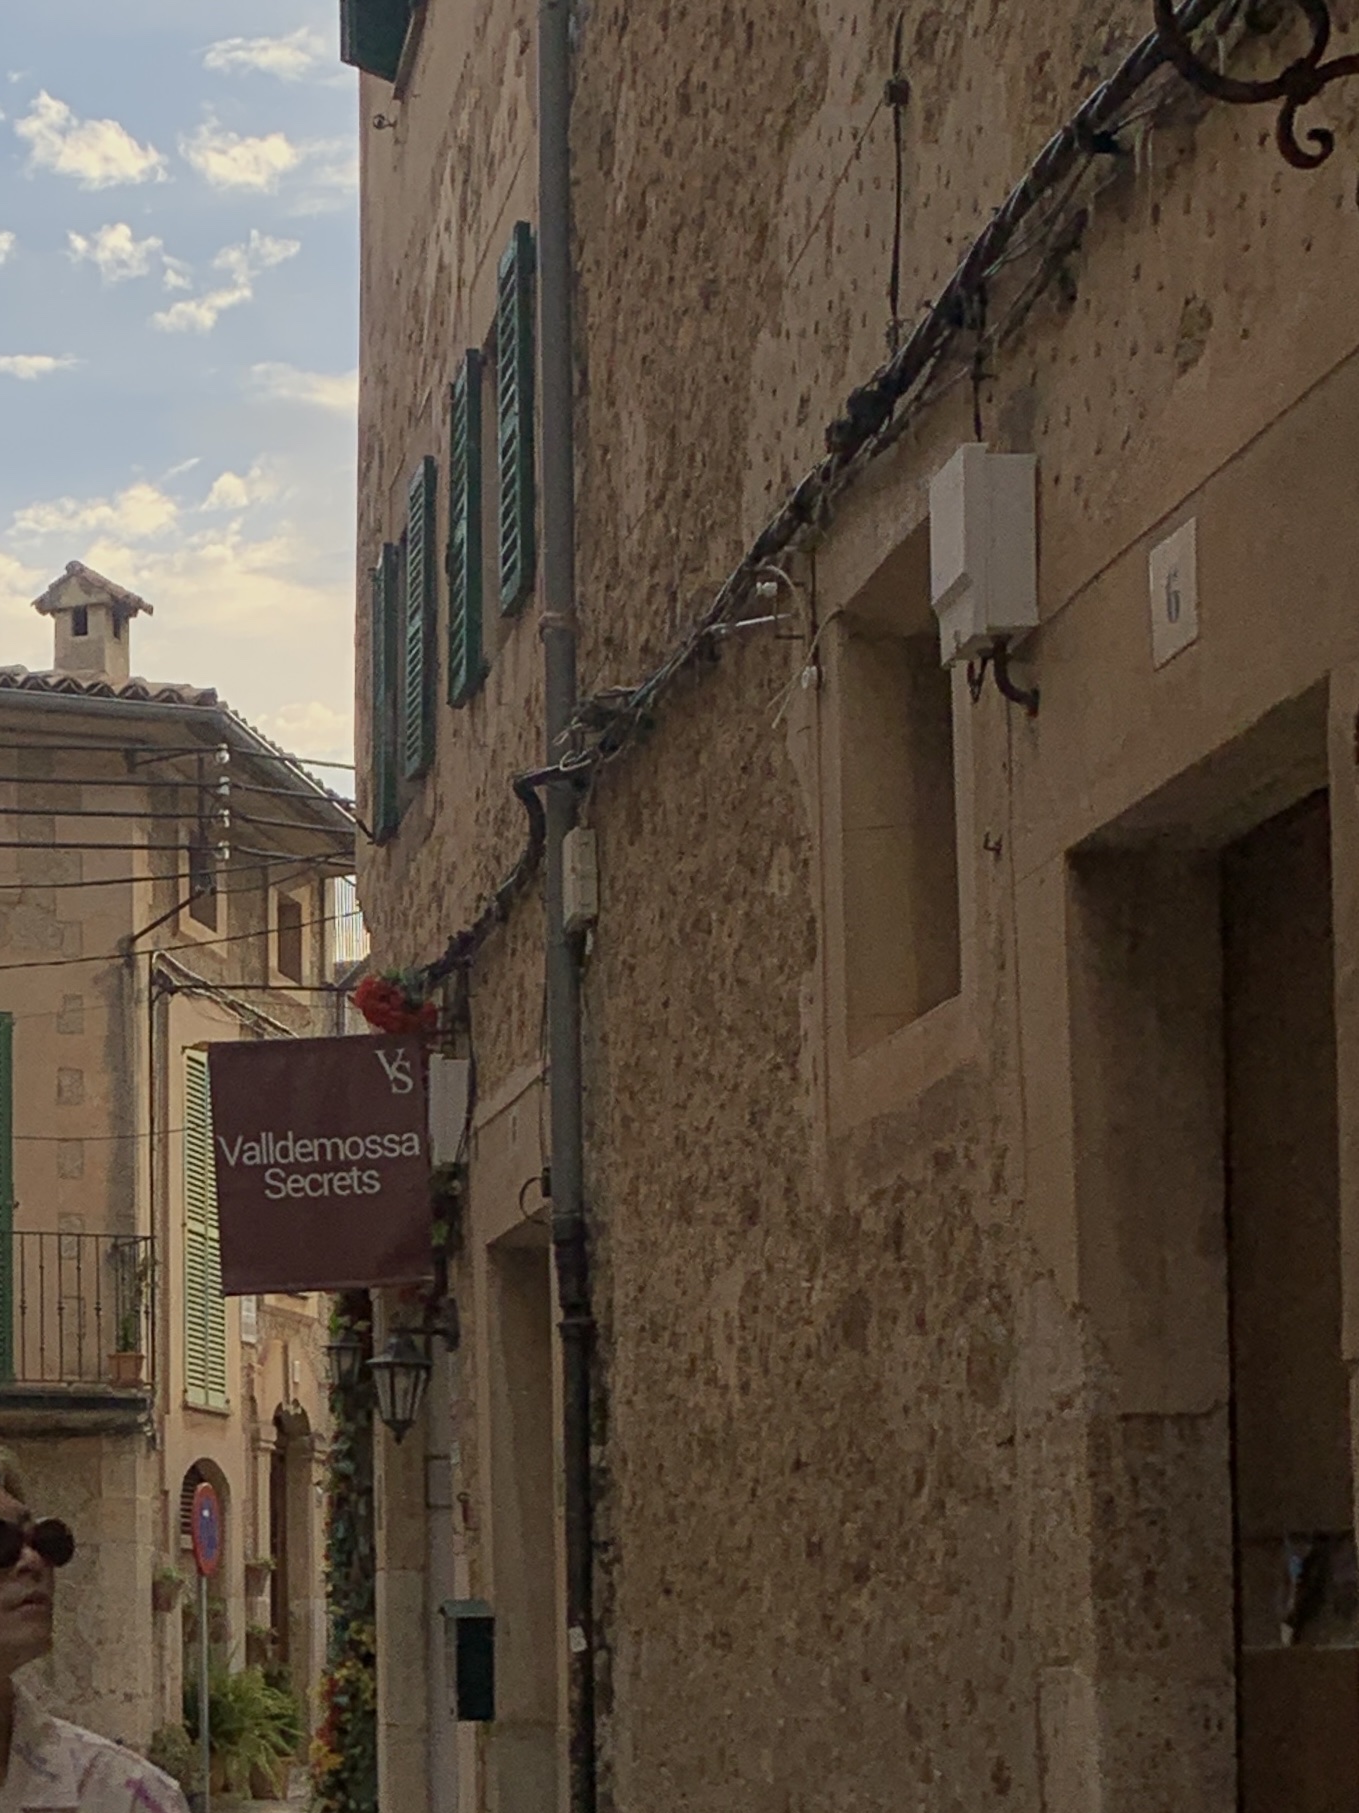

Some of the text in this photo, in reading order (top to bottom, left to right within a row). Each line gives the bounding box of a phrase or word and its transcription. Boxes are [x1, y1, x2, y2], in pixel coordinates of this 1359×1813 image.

[1165, 569, 1181, 624] 6
[217, 1131, 421, 1166] Valldemossa
[264, 1166, 382, 1199] Secrets
